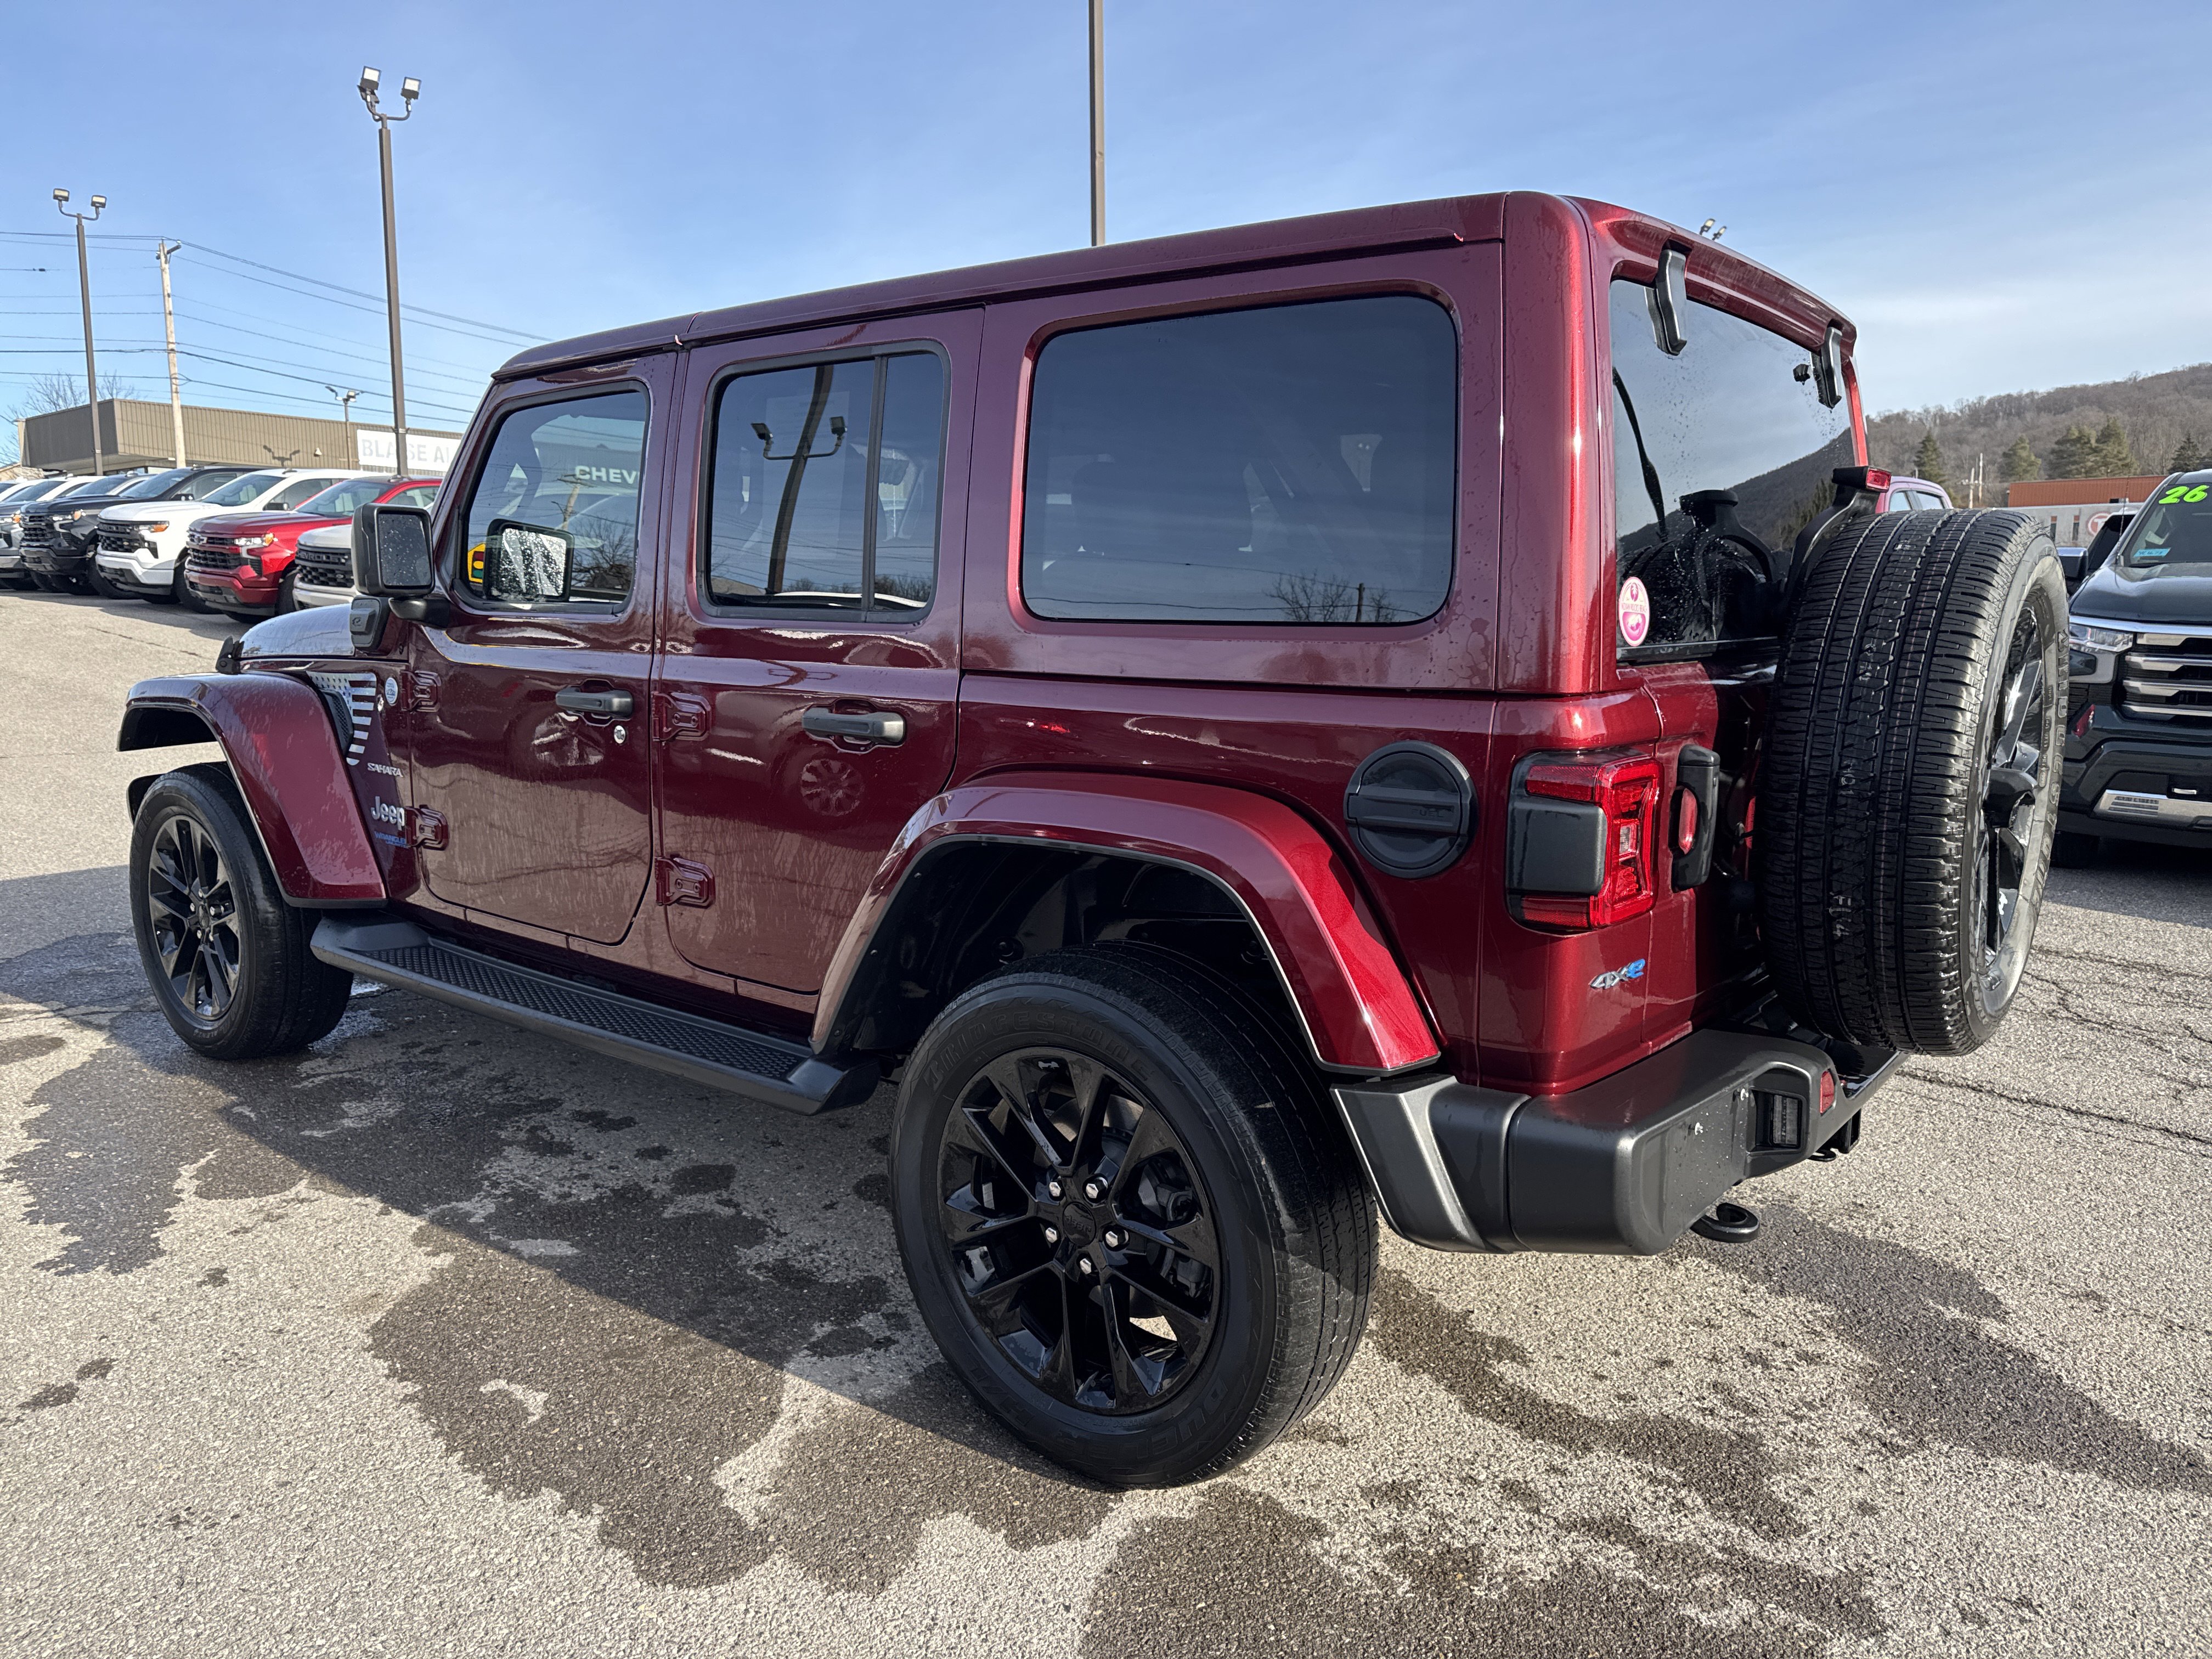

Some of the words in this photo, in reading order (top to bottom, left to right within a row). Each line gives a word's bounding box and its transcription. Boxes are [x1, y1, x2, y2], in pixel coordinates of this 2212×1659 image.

[362, 439, 427, 462] BLASE
[575, 465, 640, 484] CHEV
[2159, 485, 2209, 504] 26
[367, 763, 403, 777] SAHARA
[371, 796, 405, 831] Jeep
[374, 831, 407, 845] WRANGLE
[923, 1011, 1151, 1091] BRIDGESTONE
